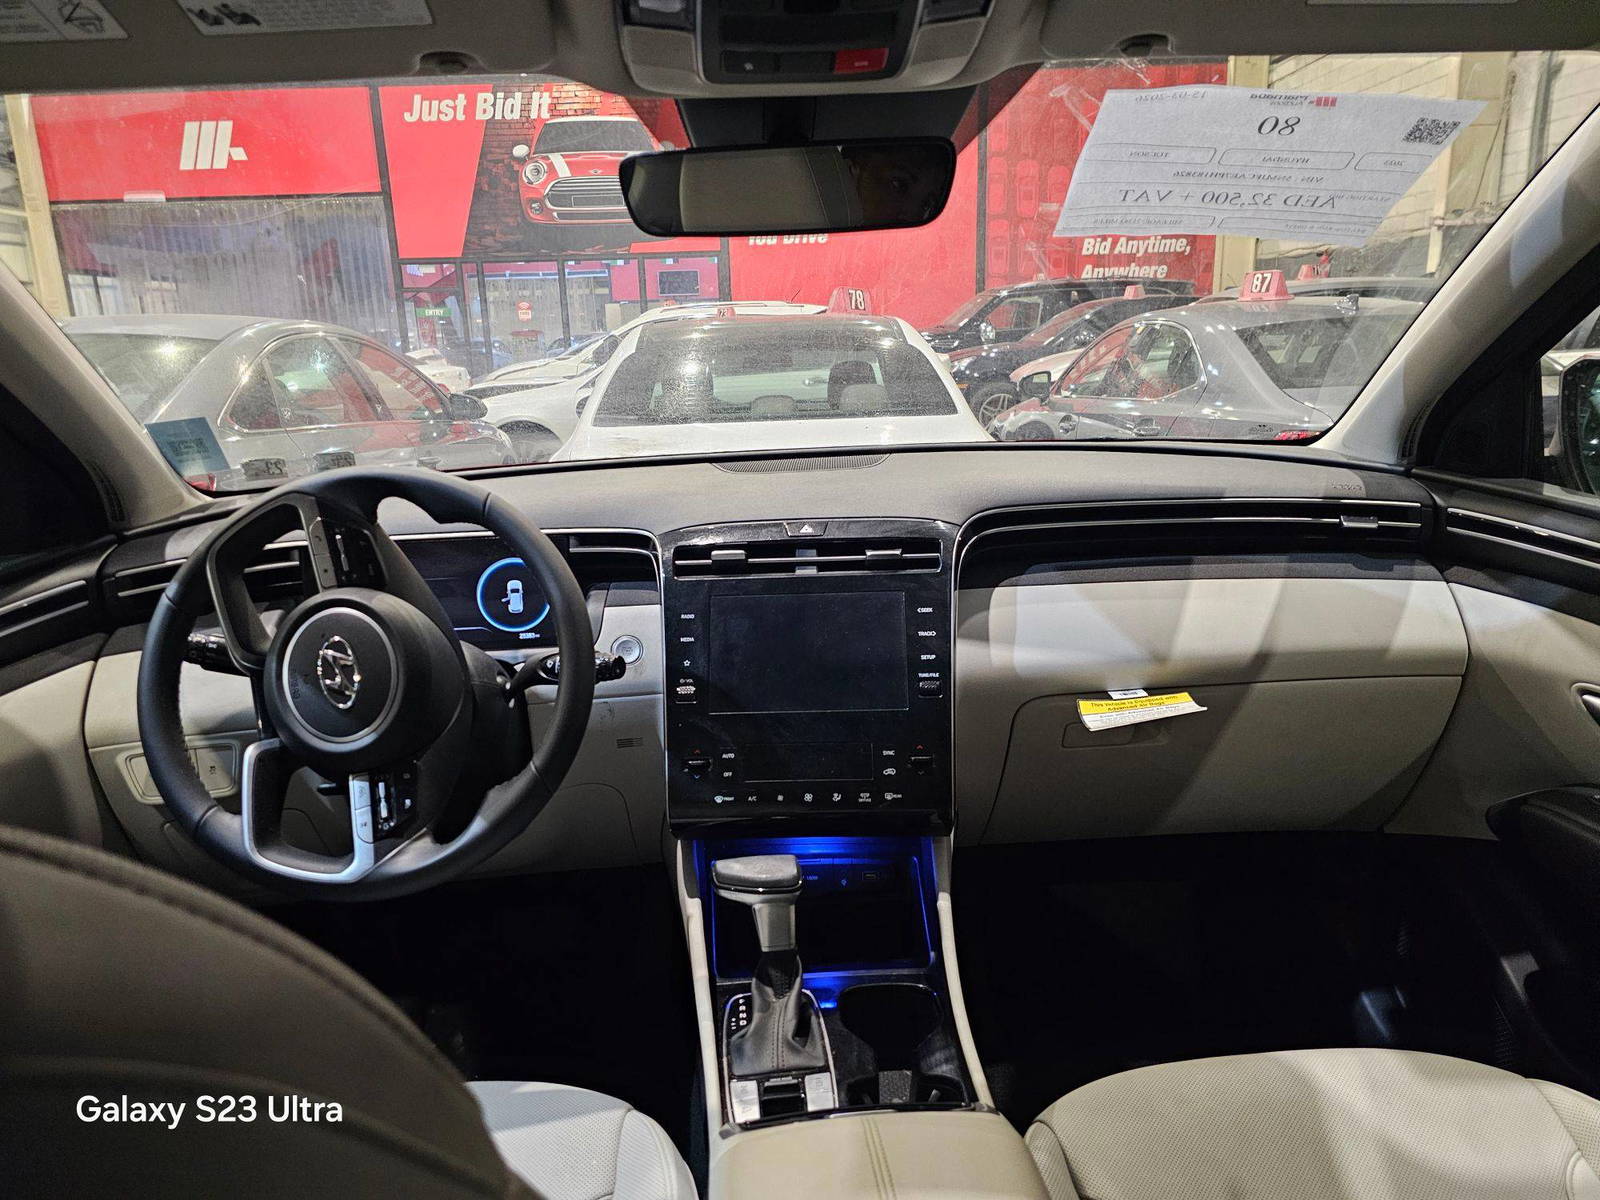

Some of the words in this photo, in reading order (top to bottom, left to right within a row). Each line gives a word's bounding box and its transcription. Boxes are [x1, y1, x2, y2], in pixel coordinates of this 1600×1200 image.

[404, 94, 467, 122] Just
[475, 92, 522, 120] Bid
[530, 92, 551, 119] It
[1082, 238, 1110, 255] Bid
[1113, 236, 1191, 257] Anytime,
[1081, 263, 1168, 279] Anywhere
[1251, 273, 1271, 294] 87
[848, 289, 865, 310] 78
[425, 308, 444, 316] ENTRY
